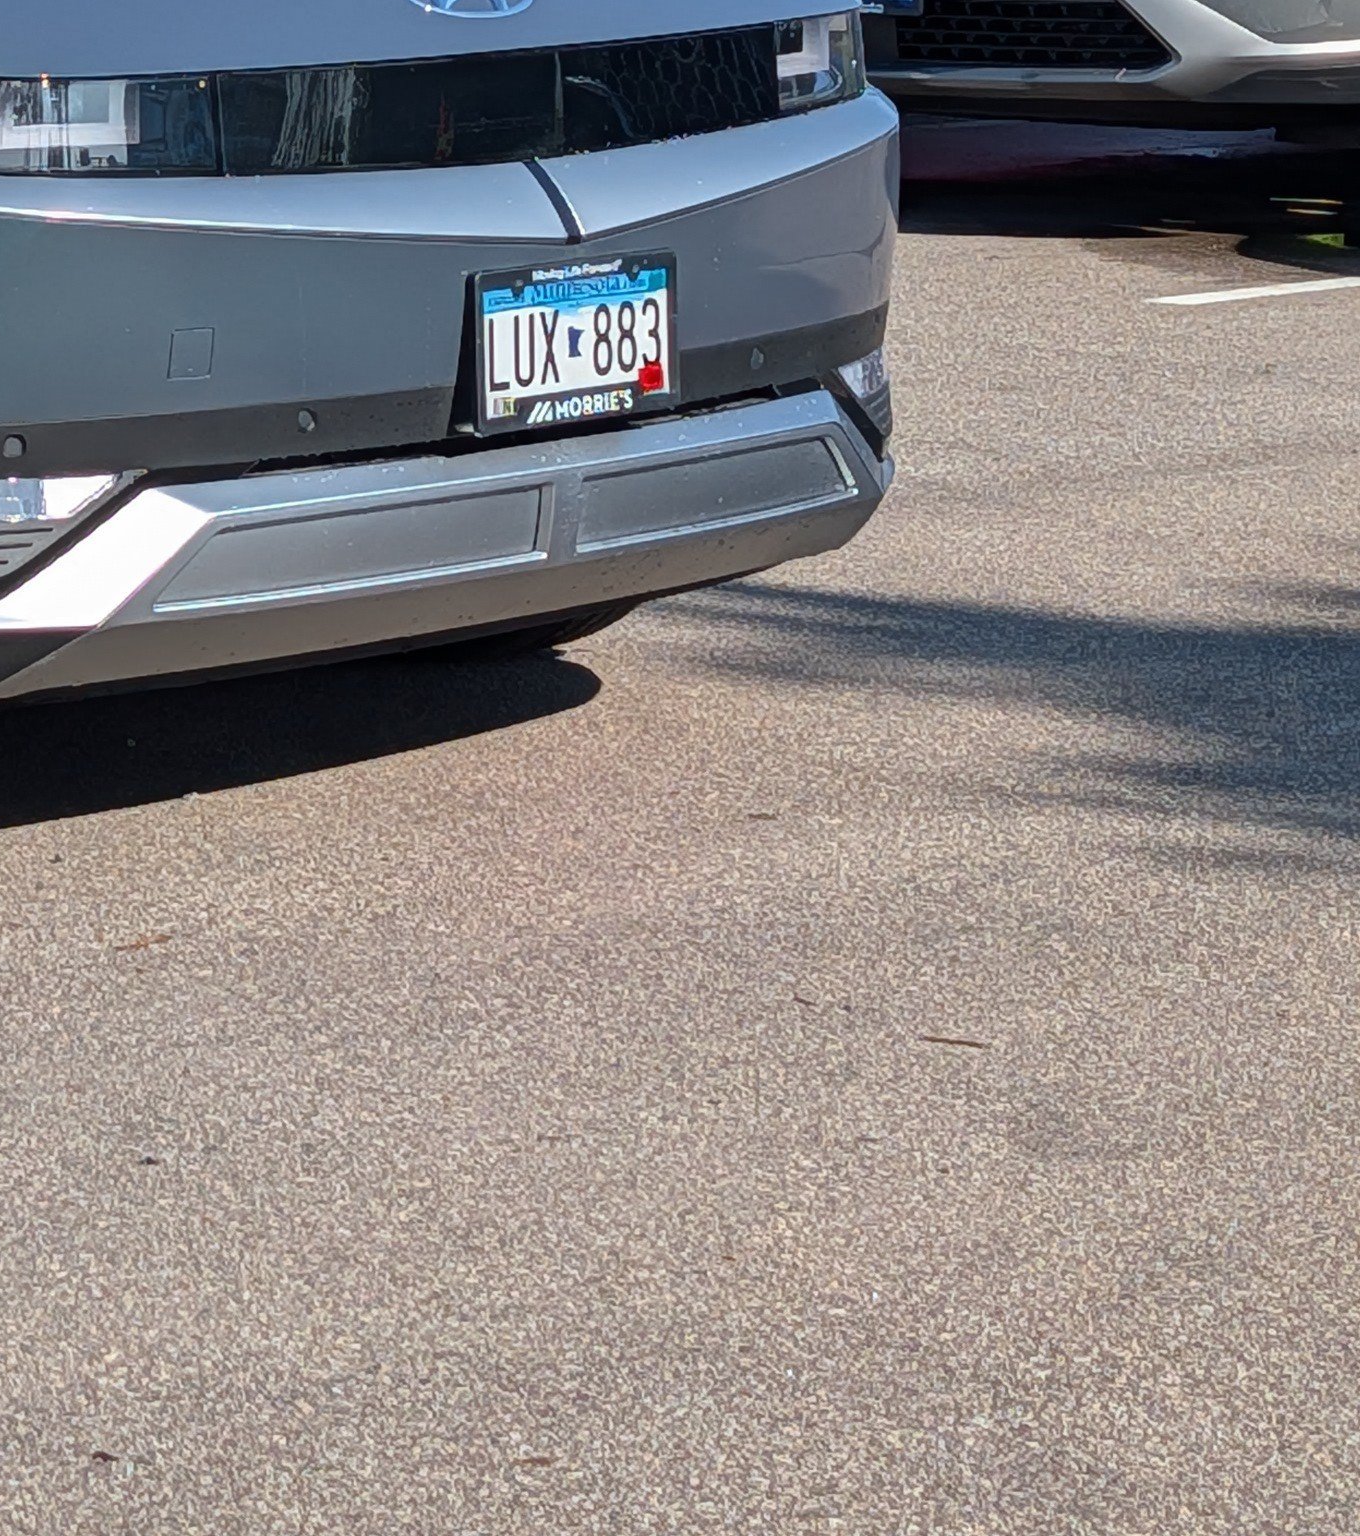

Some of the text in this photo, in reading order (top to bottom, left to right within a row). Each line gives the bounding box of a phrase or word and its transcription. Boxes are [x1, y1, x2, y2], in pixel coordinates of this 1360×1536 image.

[488, 297, 662, 392] LUX 883
[555, 389, 634, 419] MORRIE'S
